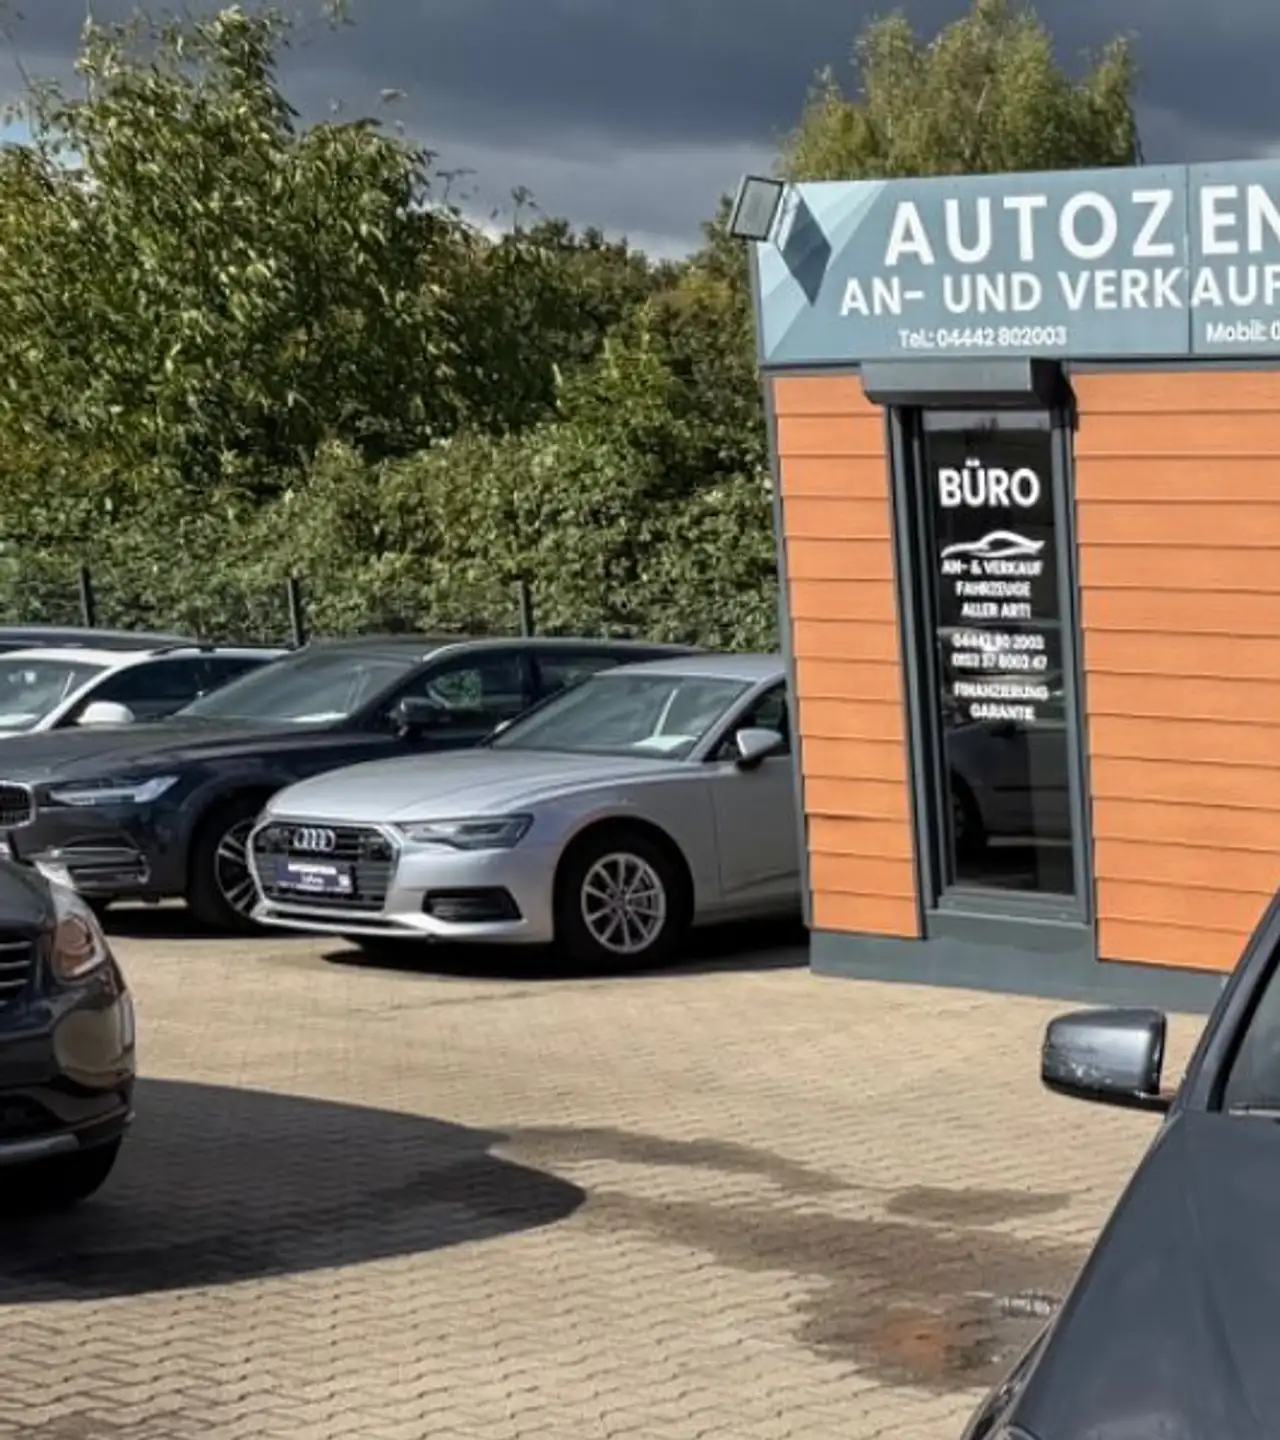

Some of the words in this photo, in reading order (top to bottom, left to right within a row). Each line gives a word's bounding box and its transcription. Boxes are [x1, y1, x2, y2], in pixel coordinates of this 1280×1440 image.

[840, 274, 924, 317] AN-
[943, 270, 1043, 313] UND
[936, 327, 995, 348] 04442
[998, 325, 1068, 345] 802003
[938, 457, 1040, 508] BÜRO
[983, 559, 1044, 577] VERKAUF
[955, 580, 1031, 597] FAHRZEUGE
[961, 601, 999, 618] ALLER
